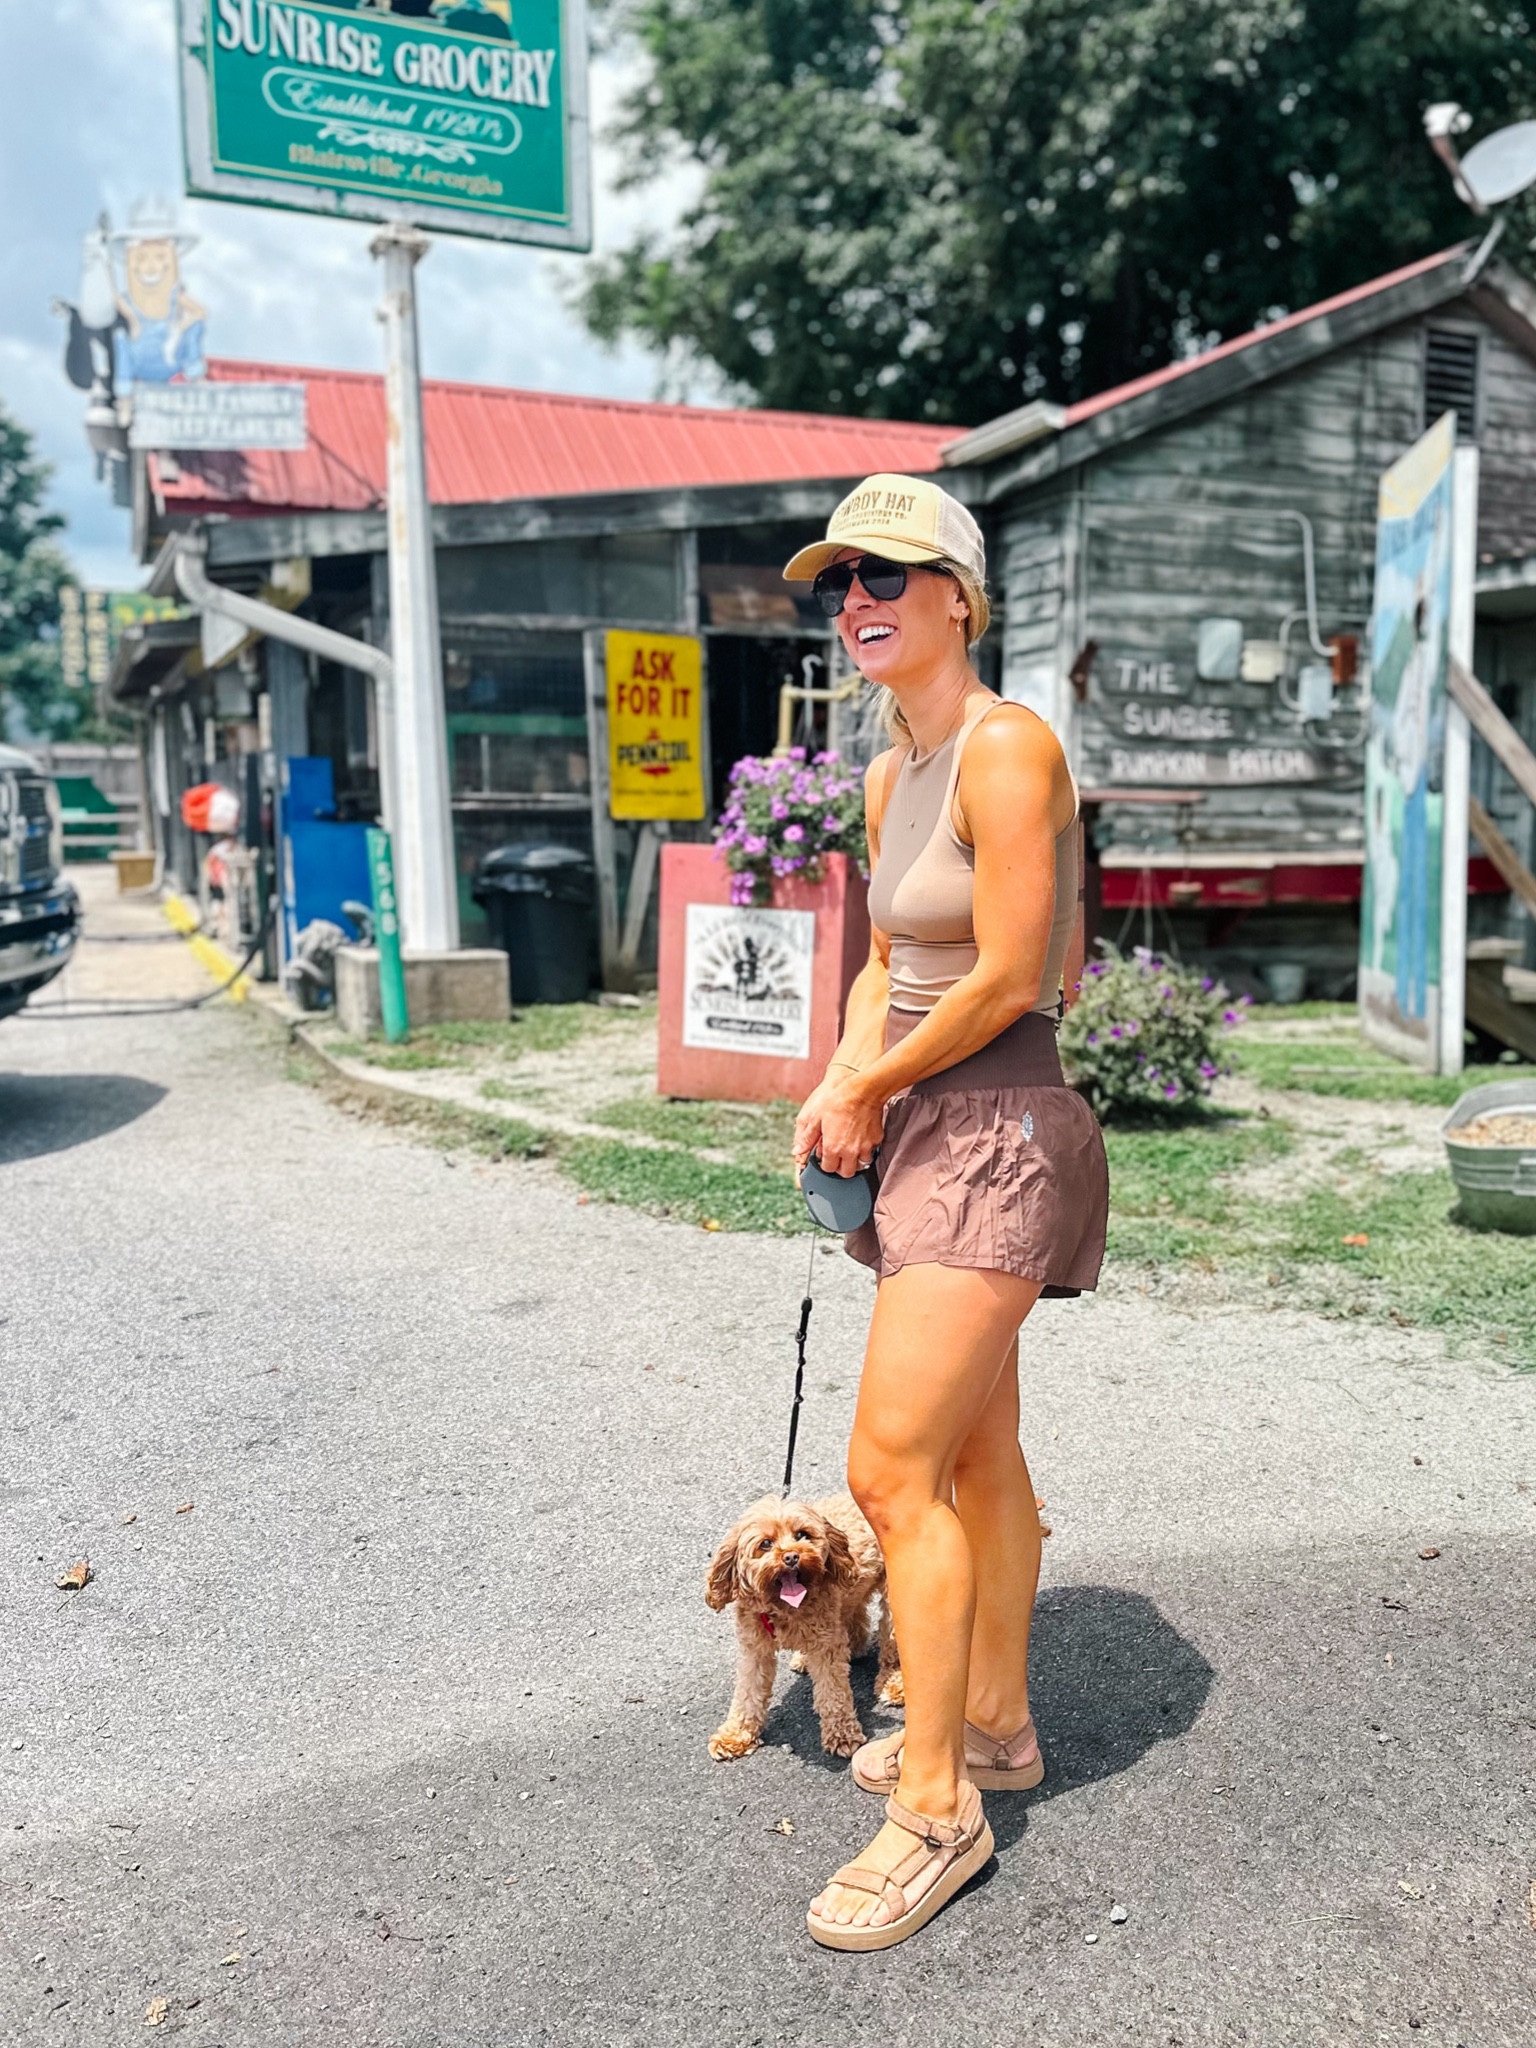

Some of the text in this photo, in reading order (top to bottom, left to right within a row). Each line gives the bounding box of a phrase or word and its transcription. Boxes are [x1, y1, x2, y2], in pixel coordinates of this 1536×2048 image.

[217, 0, 556, 108] SUNRISE GROCERY
[284, 76, 418, 126] Established
[409, 163, 503, 196] Georgia
[836, 490, 917, 517] WBOY HAT
[633, 649, 675, 681] ASK
[1114, 658, 1180, 694] THE
[617, 683, 691, 718] FOR IT
[617, 741, 691, 767] PENNZOIL
[1110, 748, 1309, 779] PUMPKIN PATCH
